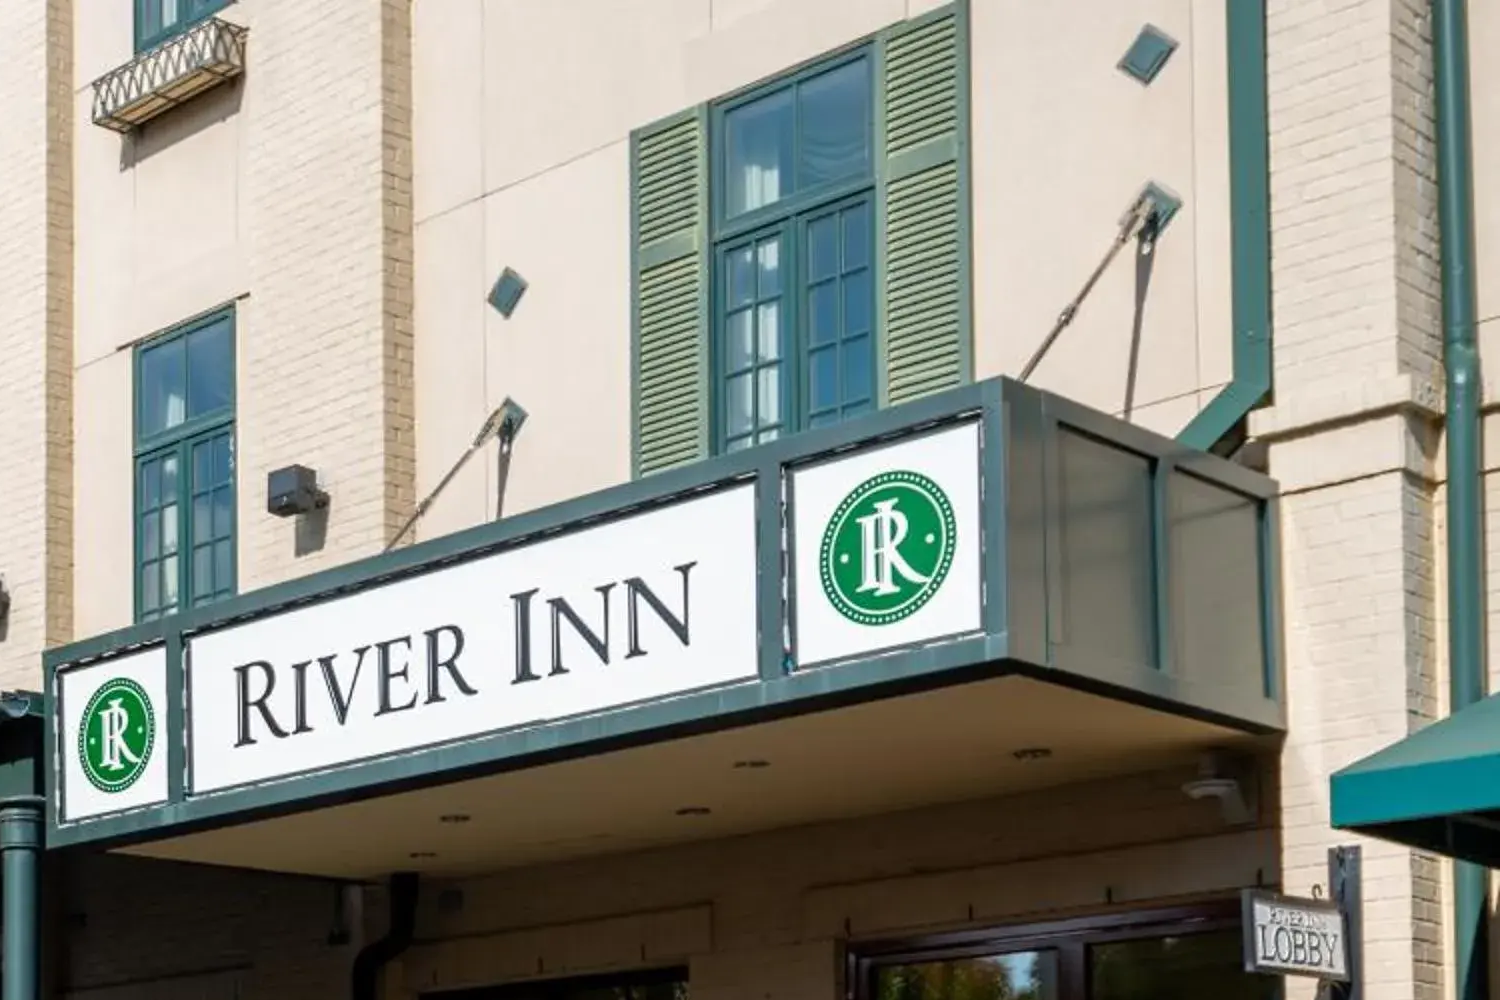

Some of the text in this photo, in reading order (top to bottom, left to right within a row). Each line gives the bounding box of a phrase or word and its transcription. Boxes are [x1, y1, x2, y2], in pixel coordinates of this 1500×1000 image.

[233, 561, 698, 748] RIVER INN
[1257, 922, 1339, 968] LOBBY
